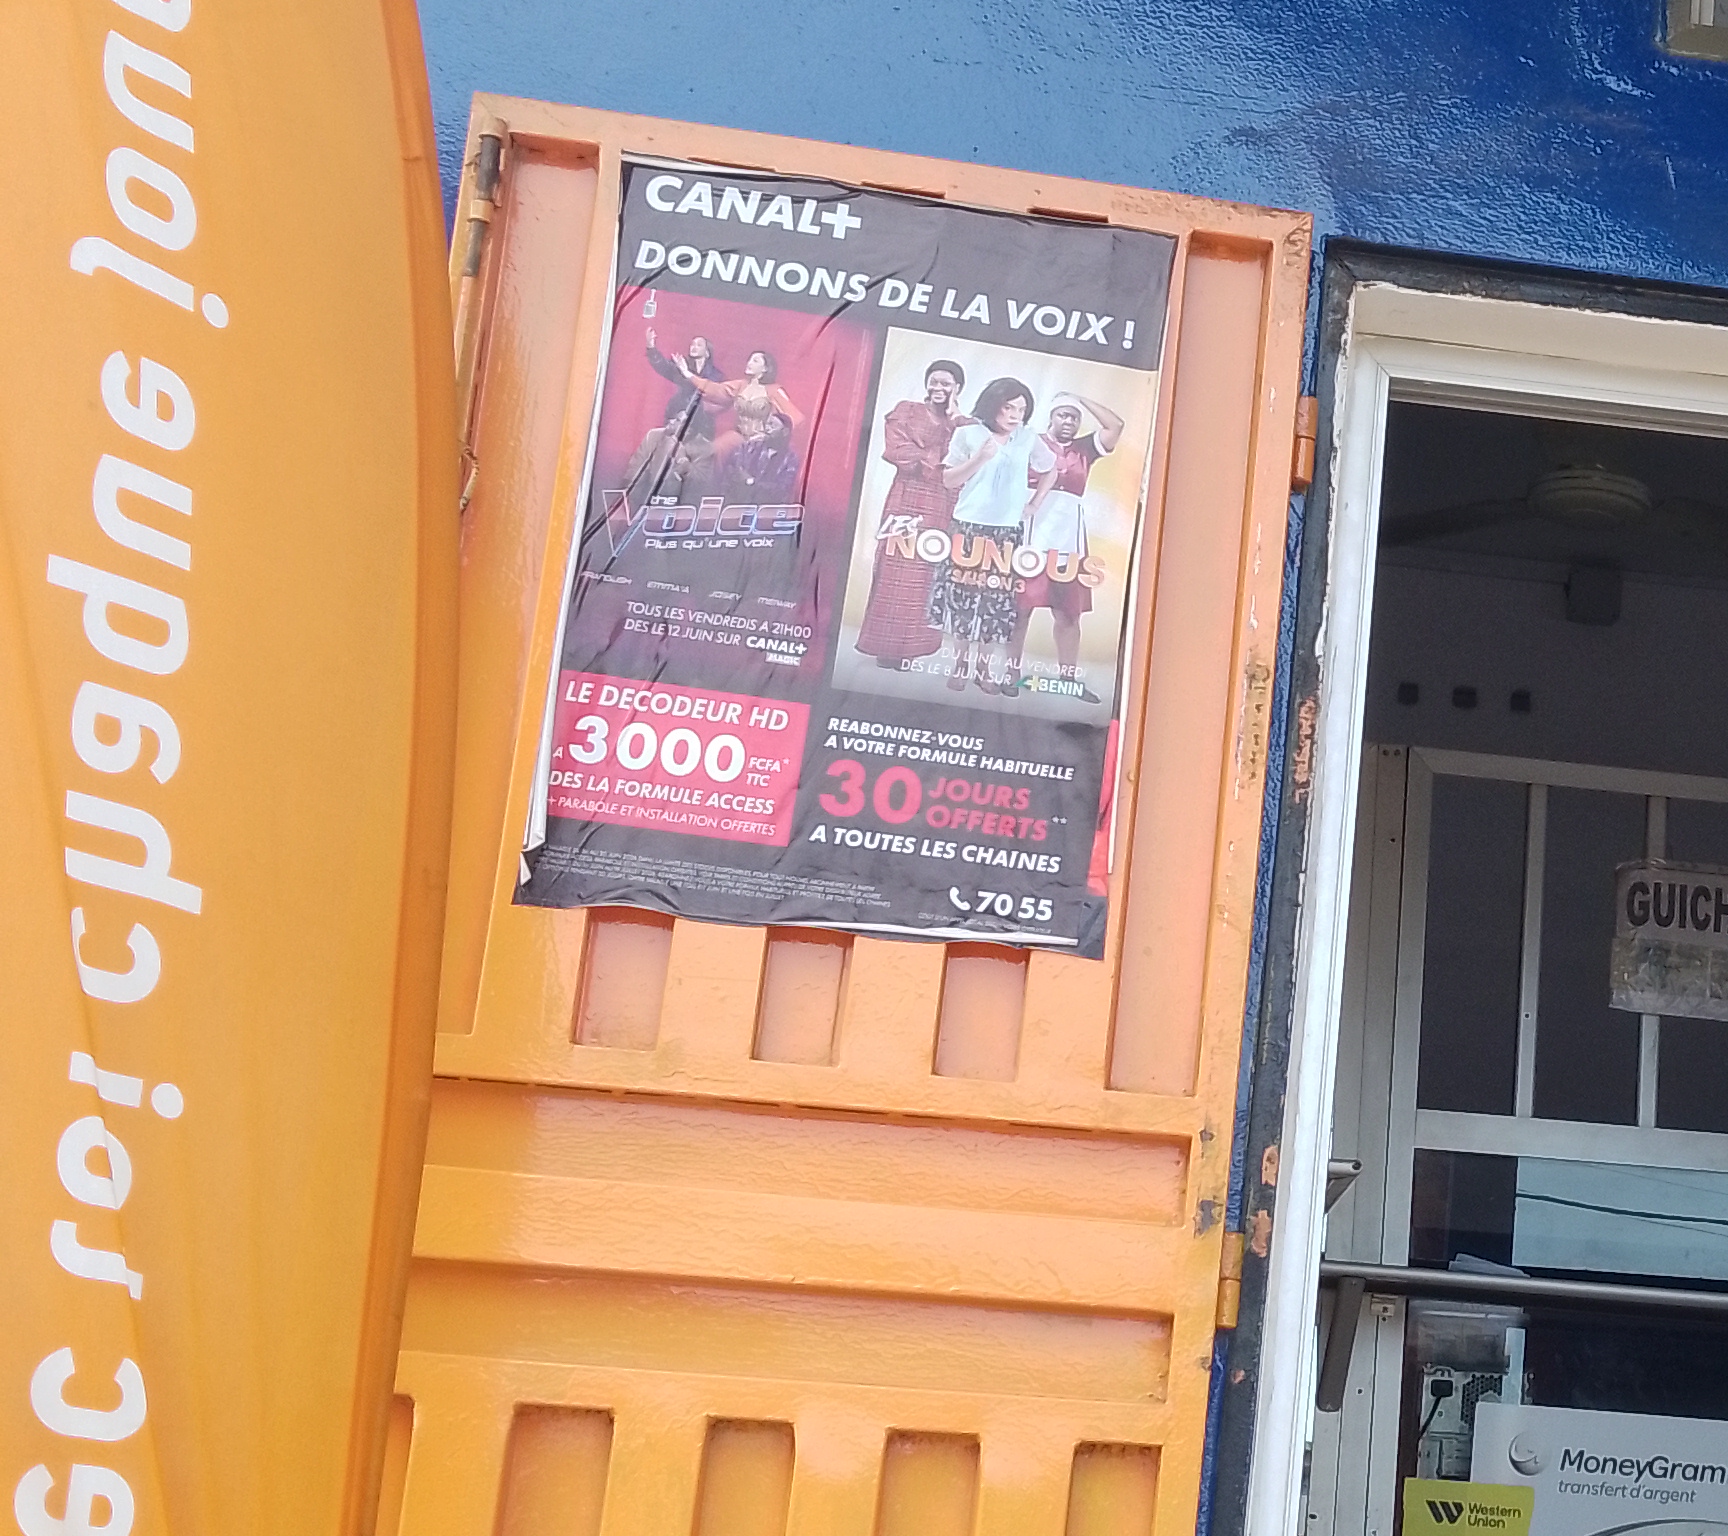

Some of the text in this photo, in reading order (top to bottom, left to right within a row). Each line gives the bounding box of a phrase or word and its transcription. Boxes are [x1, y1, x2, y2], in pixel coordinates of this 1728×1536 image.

[645, 174, 862, 240] CANAL+
[633, 239, 1136, 350] DONNONS DE LA VOIX !
[885, 528, 1107, 589] NOUNOUS
[1014, 578, 1028, 594] 3
[626, 600, 813, 640] TOUS LES VENDREDIS A 21H00
[651, 622, 666, 636] LE
[667, 624, 681, 638] 12
[681, 626, 714, 643] JUIN
[716, 631, 741, 647] SUR
[745, 636, 808, 655] CANAL+
[928, 664, 941, 675] LE
[953, 666, 985, 683] JUIN
[988, 671, 1012, 686] SUR
[1005, 656, 1022, 670] AU
[1026, 660, 1088, 678] VENDREDI
[565, 680, 790, 731] LE DECODEUR HD
[827, 717, 985, 751] REABONNEZ-VOUS
[824, 734, 1075, 782] A VOTRE FORMULE HABITUELLE
[586, 775, 610, 793] LA
[613, 779, 704, 806] FORMULE
[705, 792, 775, 816] ACCESS
[746, 773, 771, 787] TTC
[818, 759, 1032, 825] 30 JOURS
[557, 796, 619, 816] PARABOLE
[620, 804, 634, 817] ET
[635, 806, 719, 830] INSTALLATION
[720, 818, 777, 836] OFFERTES
[809, 824, 827, 844] A
[833, 827, 917, 855] TOUTES
[919, 838, 958, 860] LES
[975, 890, 1054, 921] 70 55
[1559, 1447, 1728, 1485] MoneyGram
[1467, 1502, 1522, 1518] Western
[1557, 1479, 1697, 1505] transfert d'argent
[1467, 1515, 1506, 1529] Union
